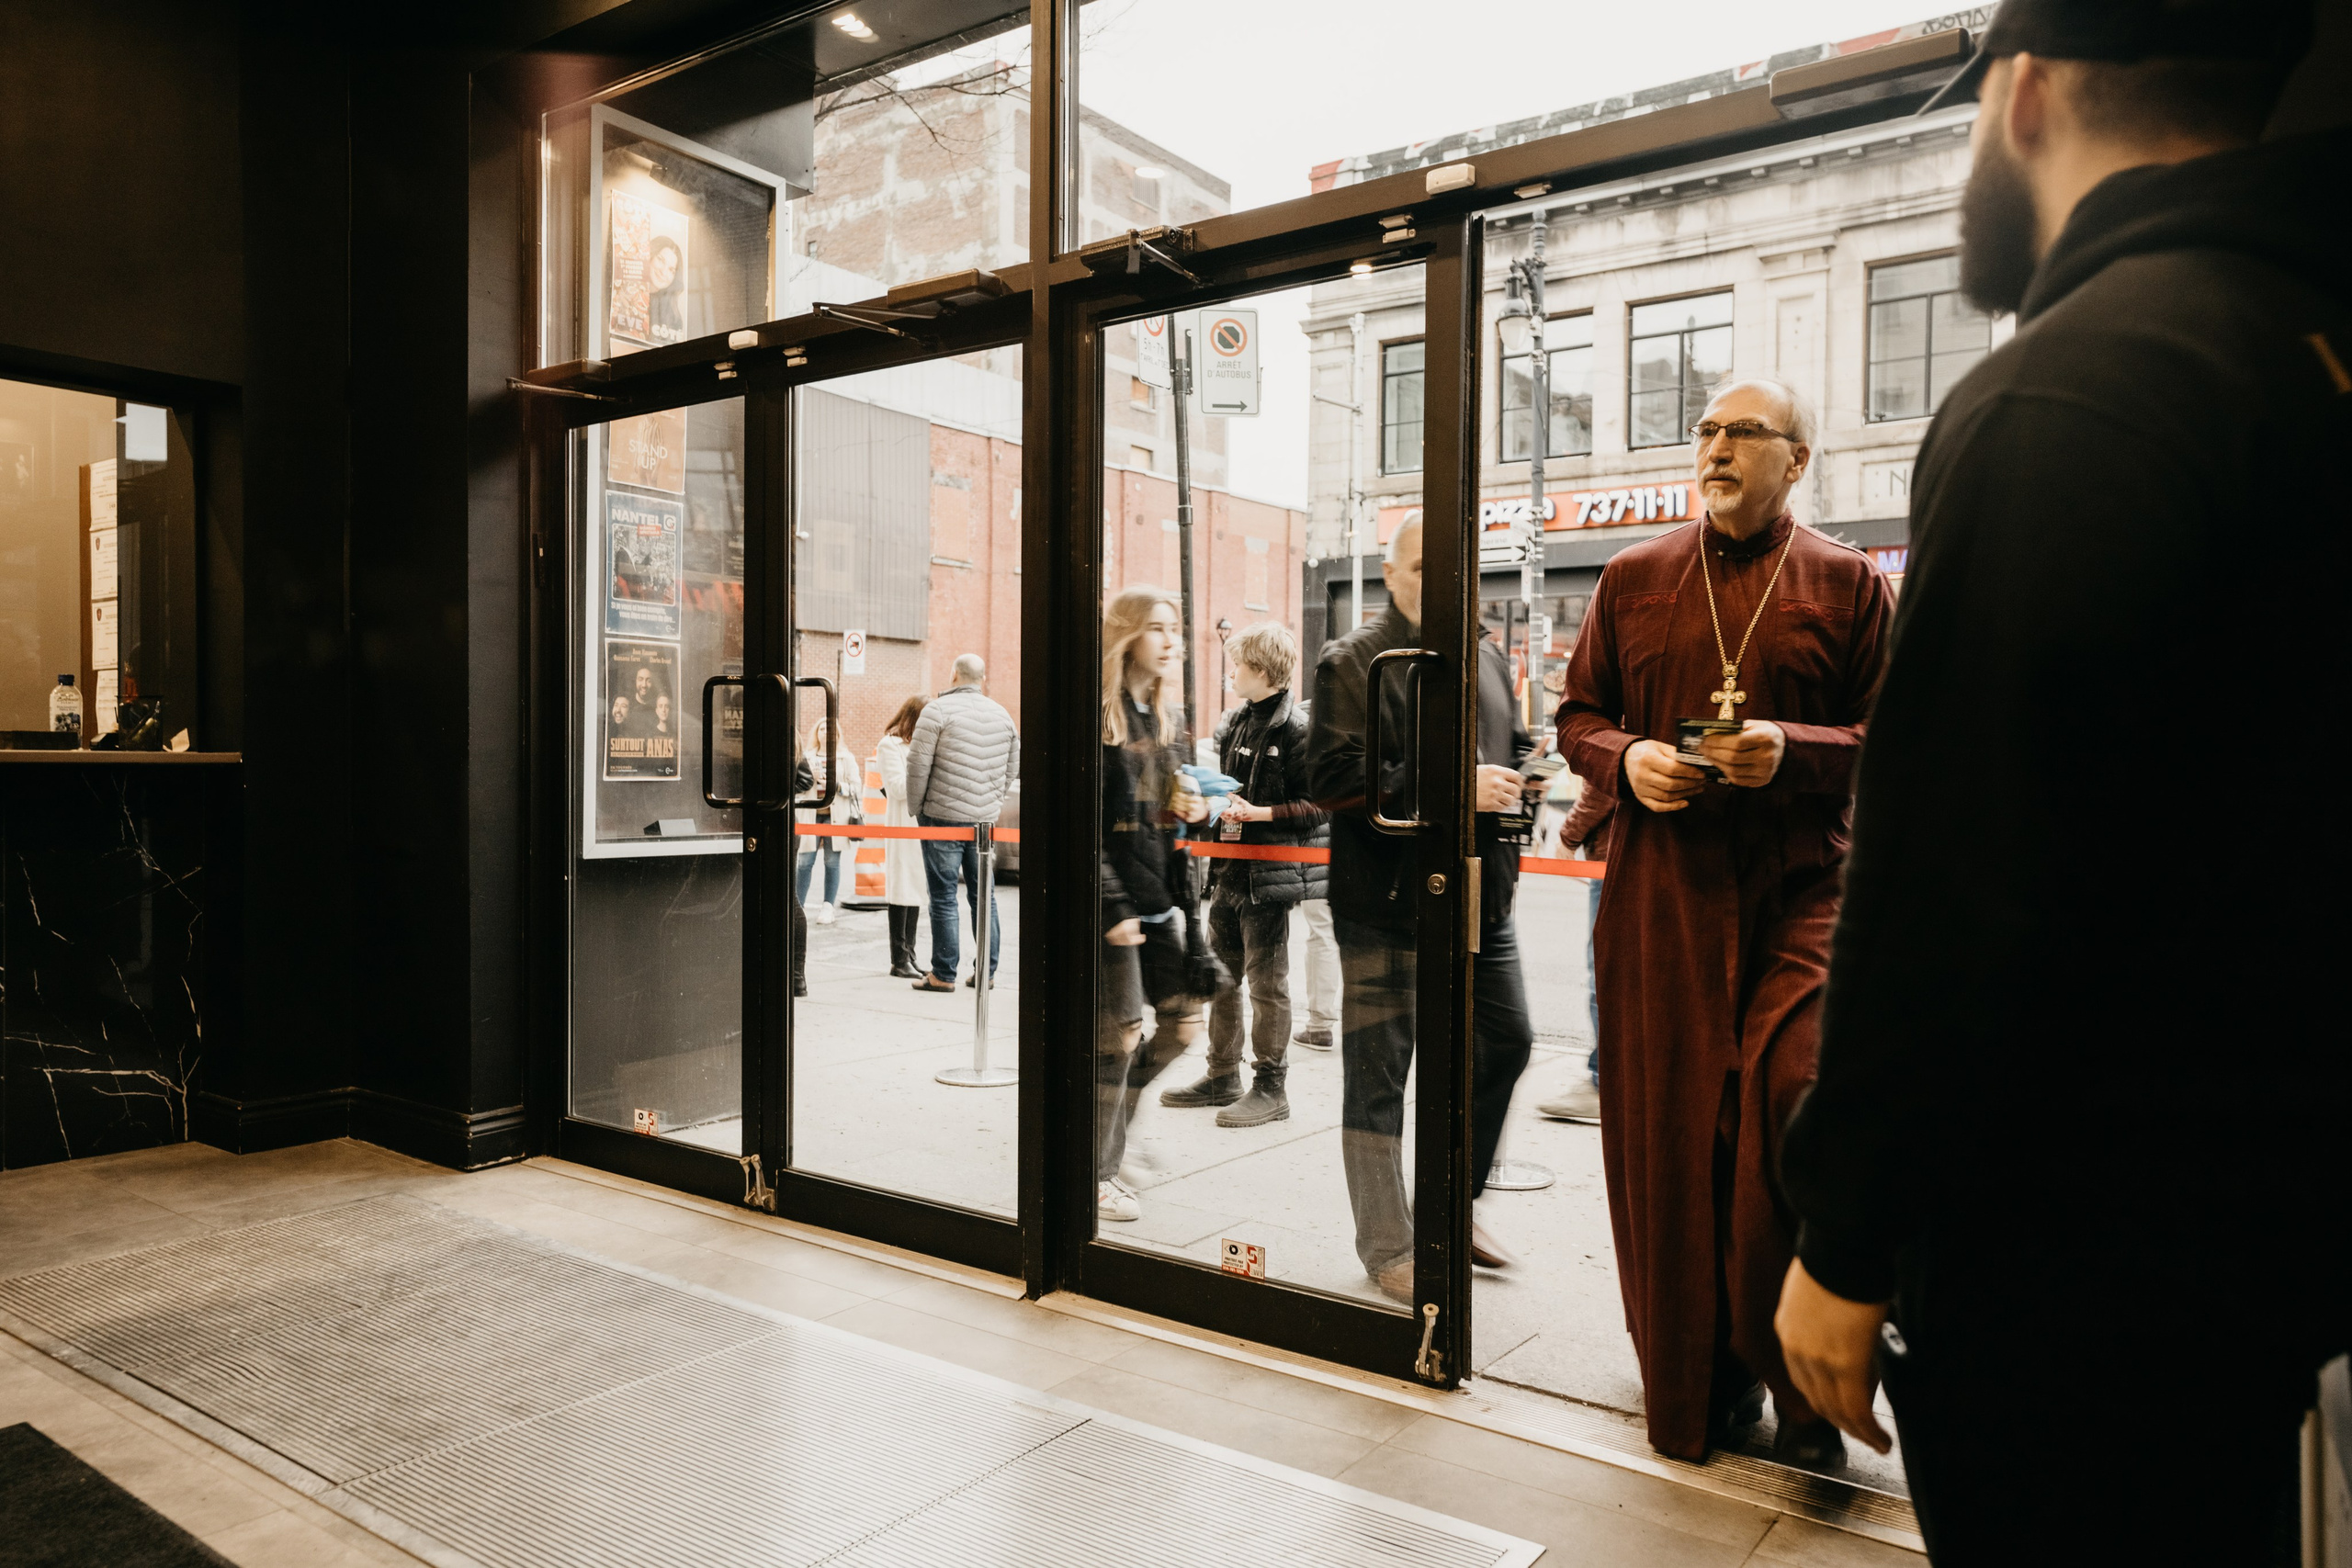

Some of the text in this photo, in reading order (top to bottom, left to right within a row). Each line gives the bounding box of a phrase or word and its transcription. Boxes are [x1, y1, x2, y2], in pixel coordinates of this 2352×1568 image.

[628, 439, 668, 459] STAND
[642, 455, 657, 470] UP
[612, 508, 662, 525] NANTEL
[610, 738, 674, 758] SURTOUT ANAS
